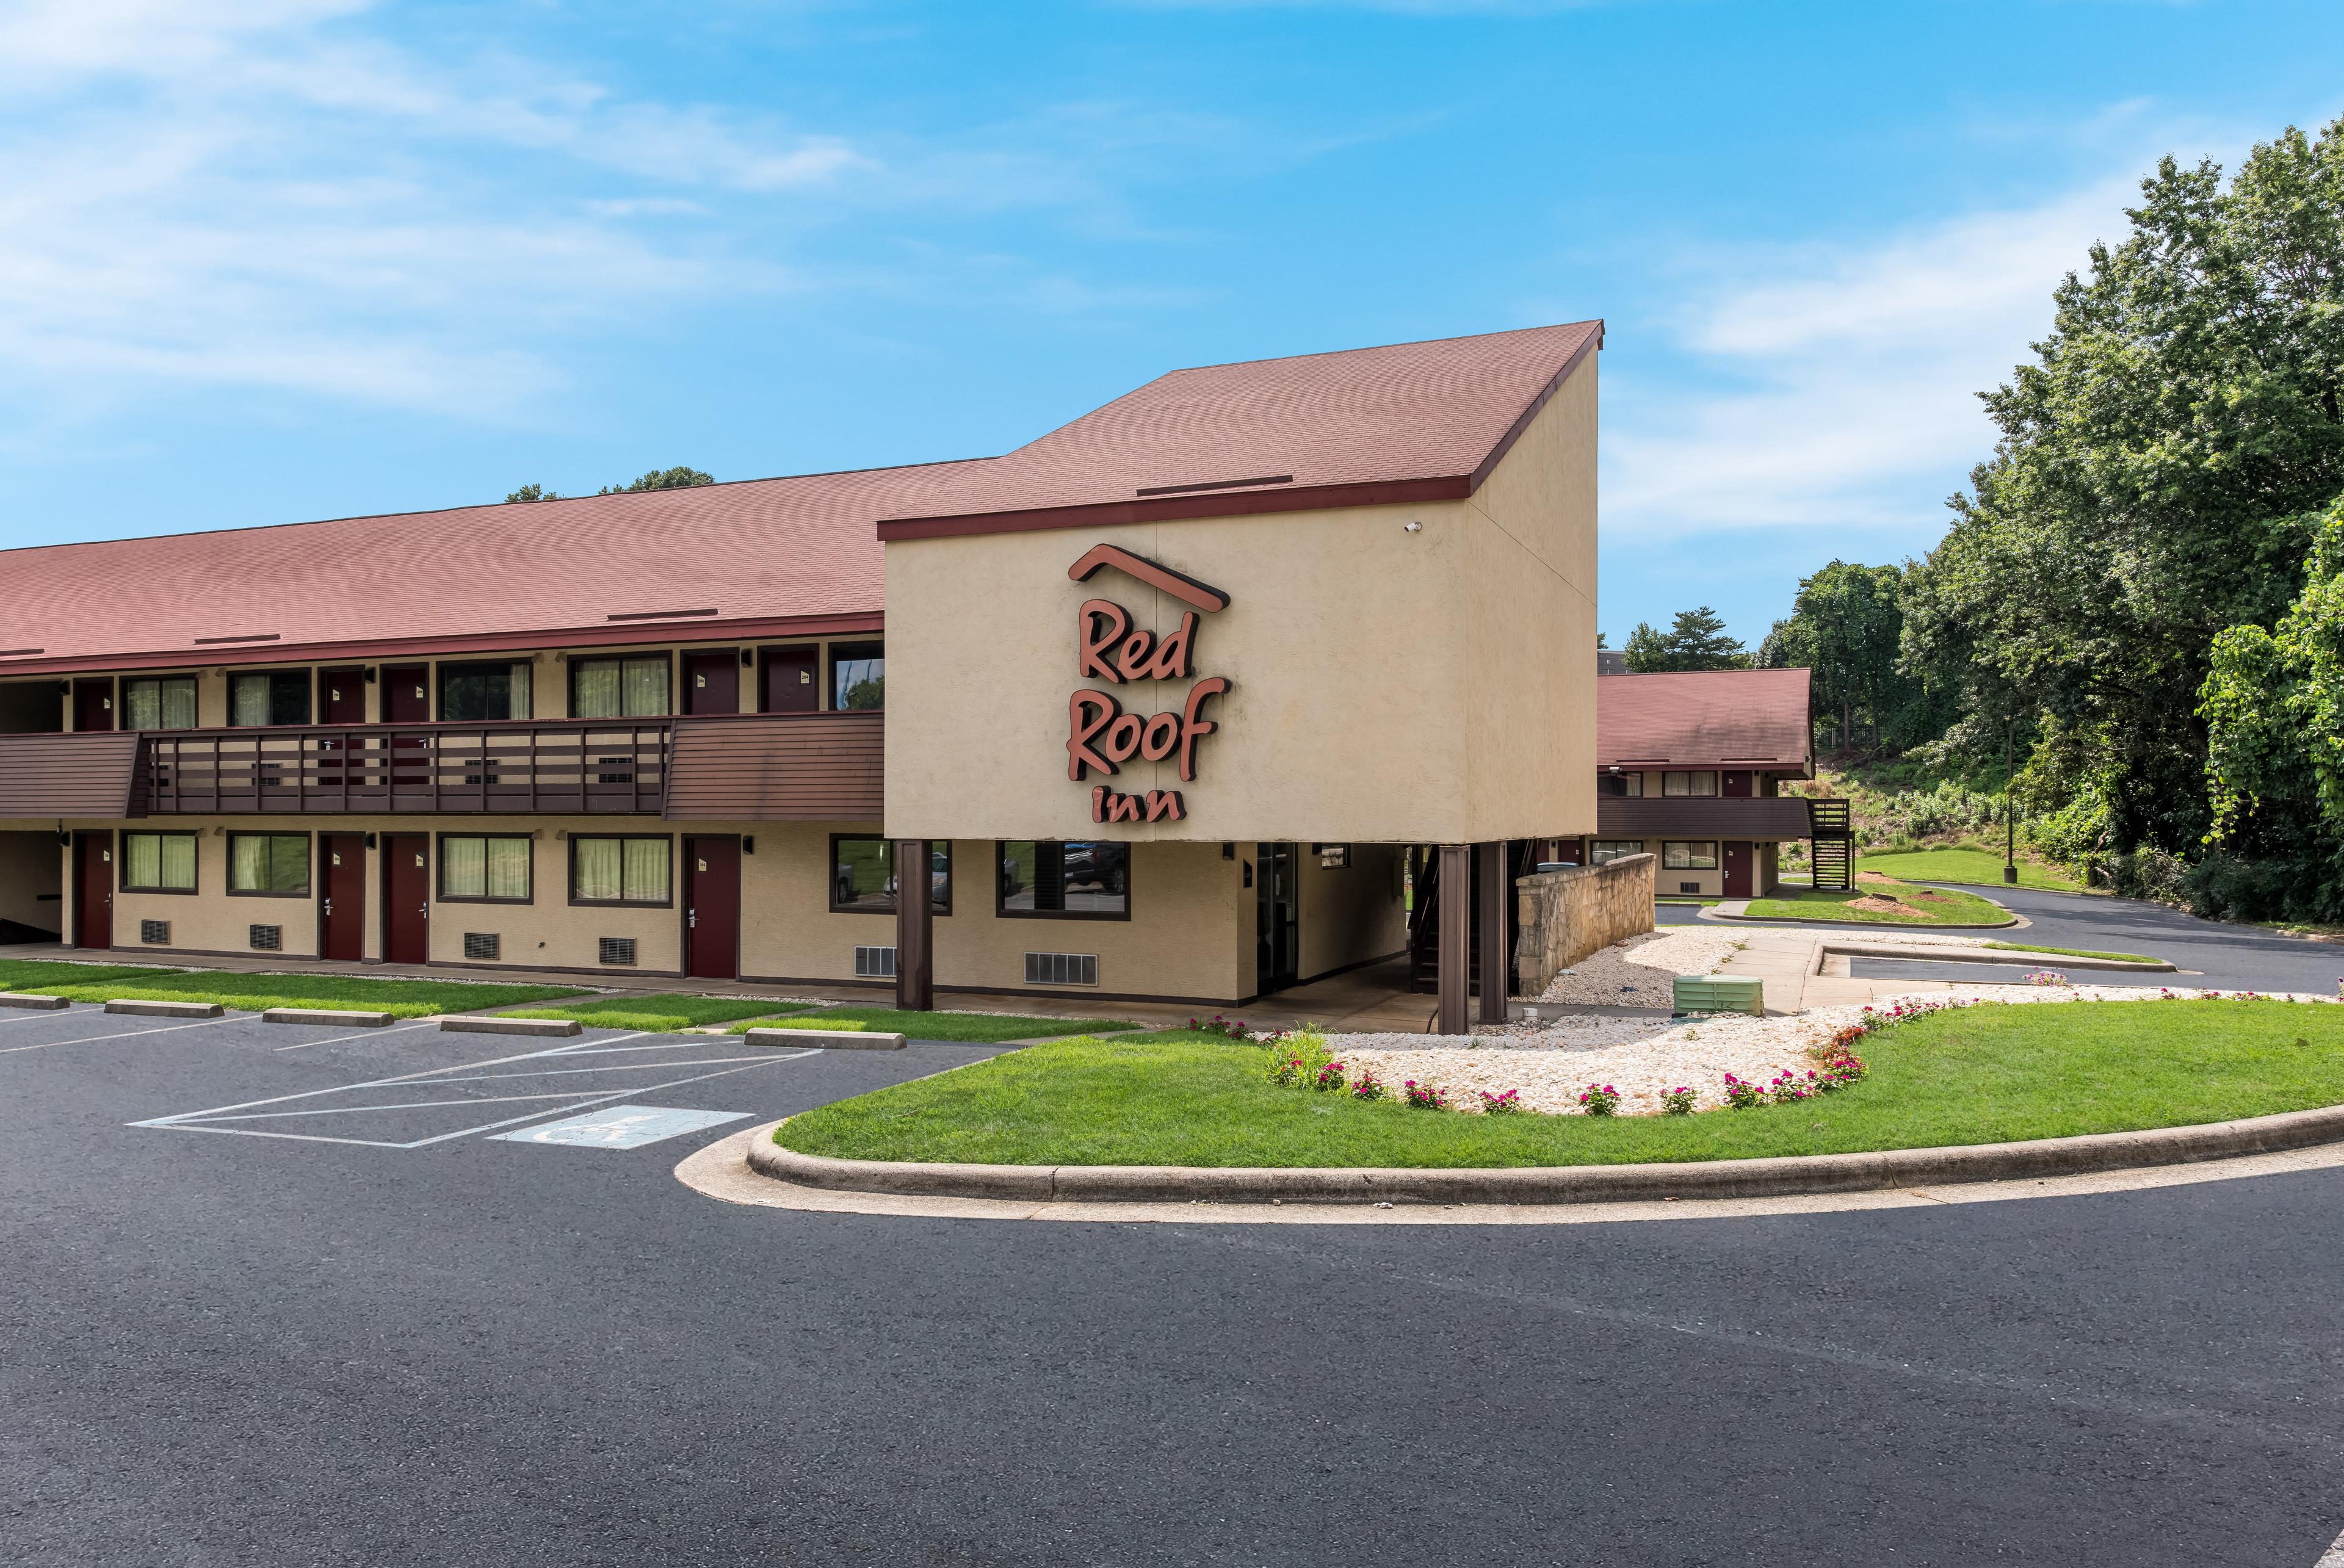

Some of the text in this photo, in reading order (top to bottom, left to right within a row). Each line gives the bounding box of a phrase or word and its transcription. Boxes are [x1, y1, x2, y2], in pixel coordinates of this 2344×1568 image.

[1079, 599, 1199, 684] Red
[1066, 677, 1231, 781] Roof
[1092, 785, 1187, 823] Inn
